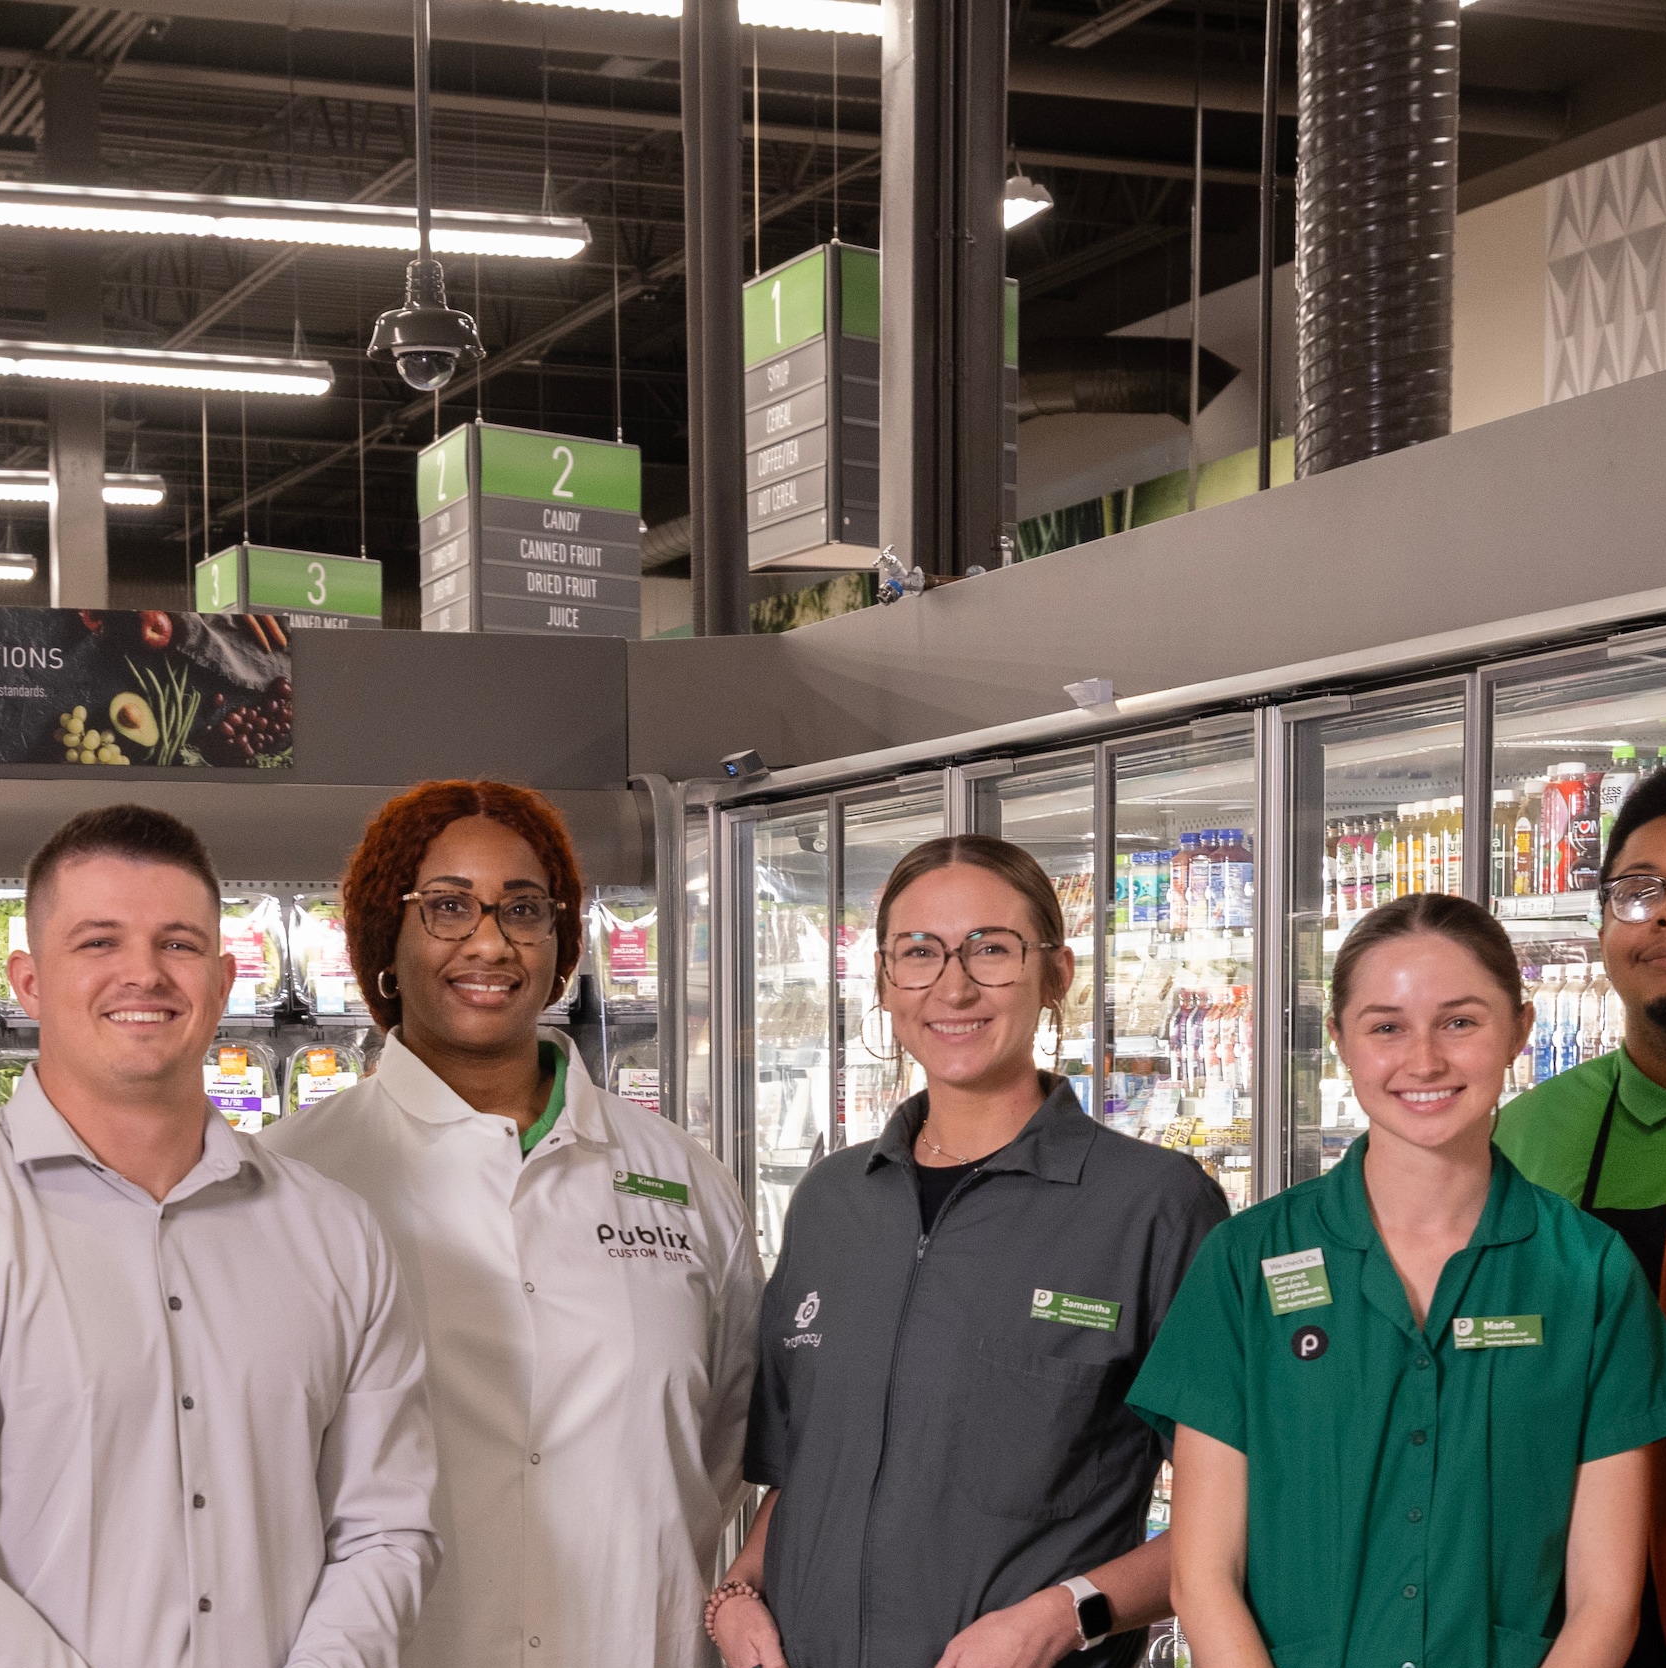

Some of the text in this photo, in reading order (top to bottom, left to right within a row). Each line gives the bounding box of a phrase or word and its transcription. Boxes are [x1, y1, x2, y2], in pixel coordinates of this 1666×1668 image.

[771, 280, 781, 343] 1
[766, 402, 791, 434] CEREAL
[552, 445, 574, 498] 2
[758, 440, 799, 477] COFFEE/TEA
[436, 449, 446, 501] 2
[773, 480, 797, 511] CEREAL
[543, 508, 581, 533] CANDY
[520, 538, 602, 568] CANNED FRUIT
[211, 563, 219, 607] 3
[307, 562, 327, 605] 3
[527, 571, 597, 598] DRIED FRUIT
[546, 605, 579, 629] JUICE
[637, 1177, 664, 1189] Kierra
[597, 1224, 692, 1250] Publix
[608, 1249, 692, 1264] CUSTOM CUTS
[1272, 1272, 1307, 1285] Carryout
[1274, 1282, 1302, 1293] service
[1062, 1298, 1111, 1314] Samantha
[1483, 1320, 1515, 1331] Marlie
